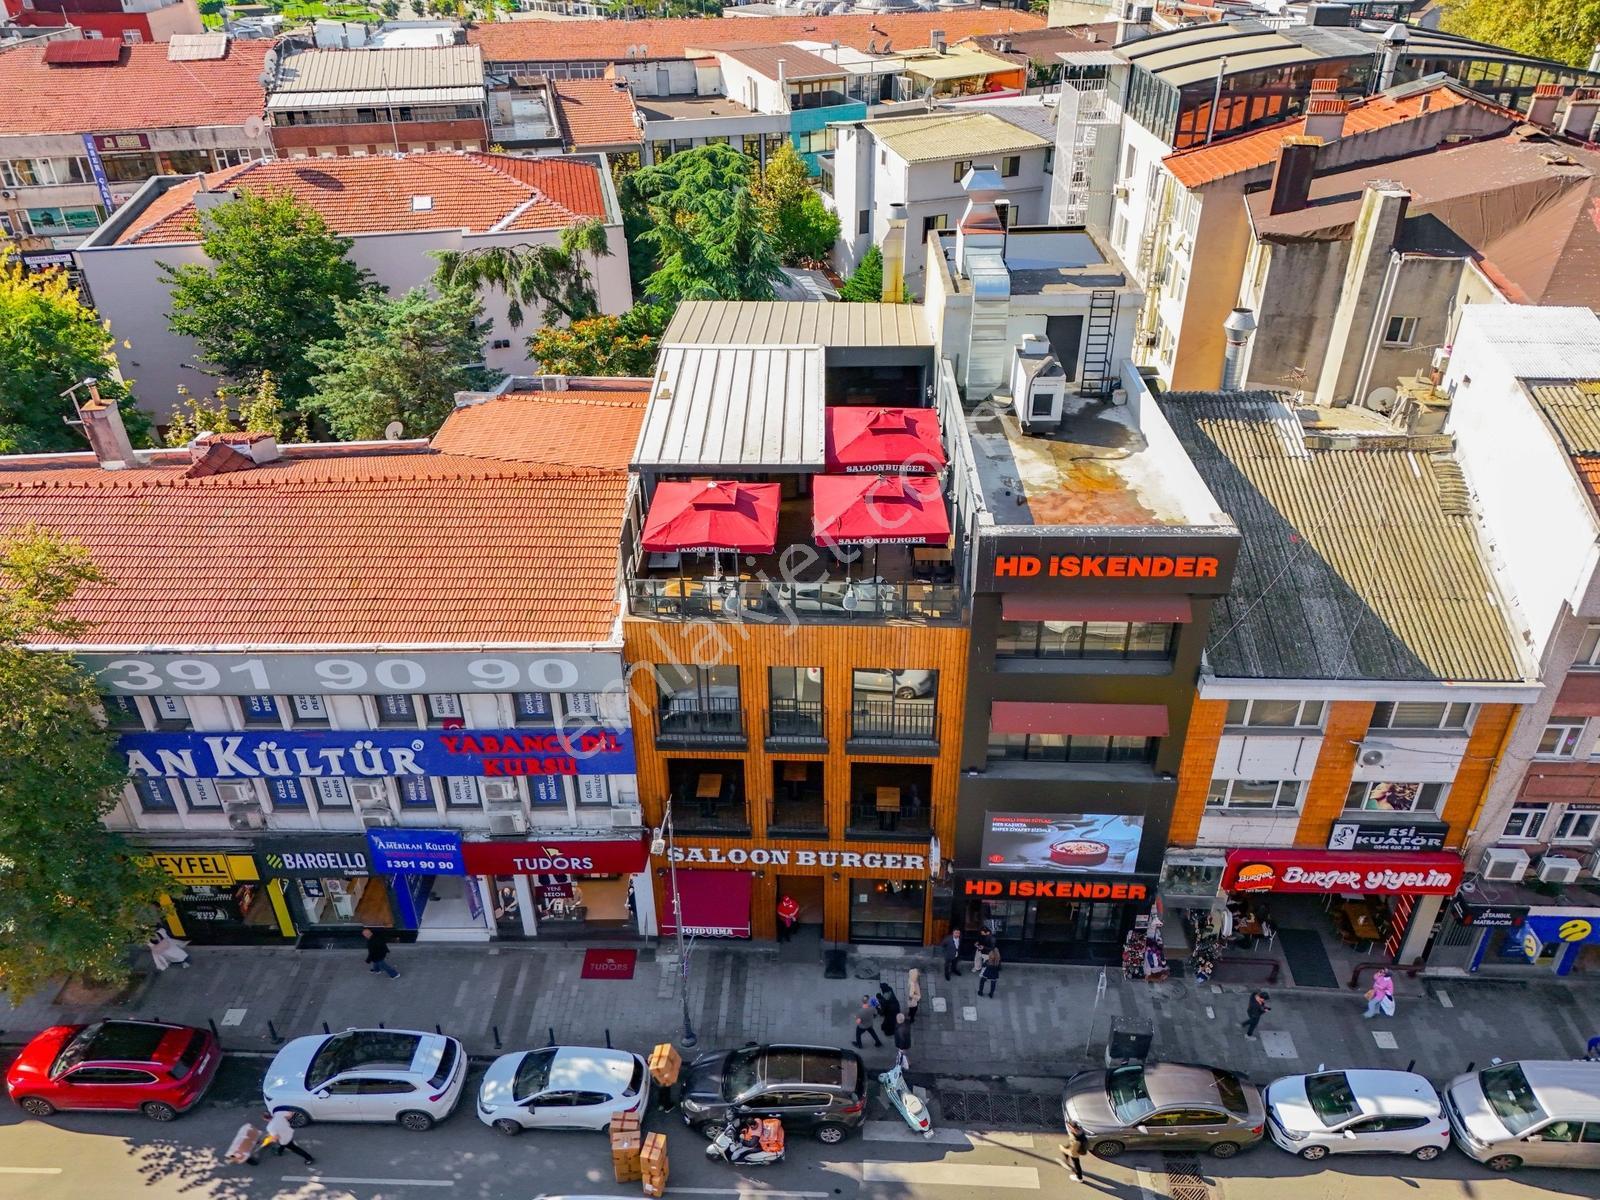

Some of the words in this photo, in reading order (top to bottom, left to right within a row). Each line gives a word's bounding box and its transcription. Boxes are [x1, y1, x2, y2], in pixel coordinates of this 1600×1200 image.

[995, 556, 1041, 577] HD
[107, 660, 272, 690] 391
[315, 659, 426, 690] 90
[467, 659, 579, 690] 90
[440, 735, 571, 754] YABANCI
[203, 736, 424, 778] KÜLTÜR
[483, 757, 577, 776] KURSU
[1355, 835, 1441, 846] KUAFÖR
[157, 857, 226, 874] EYFEL
[282, 853, 366, 869] BARGELLO
[394, 860, 415, 868] 391
[419, 861, 435, 869] 90
[439, 861, 454, 869] 90
[513, 857, 593, 870] TUDORS
[667, 847, 790, 864] SALOON
[796, 850, 925, 869] BURGER
[965, 880, 1003, 895] HD
